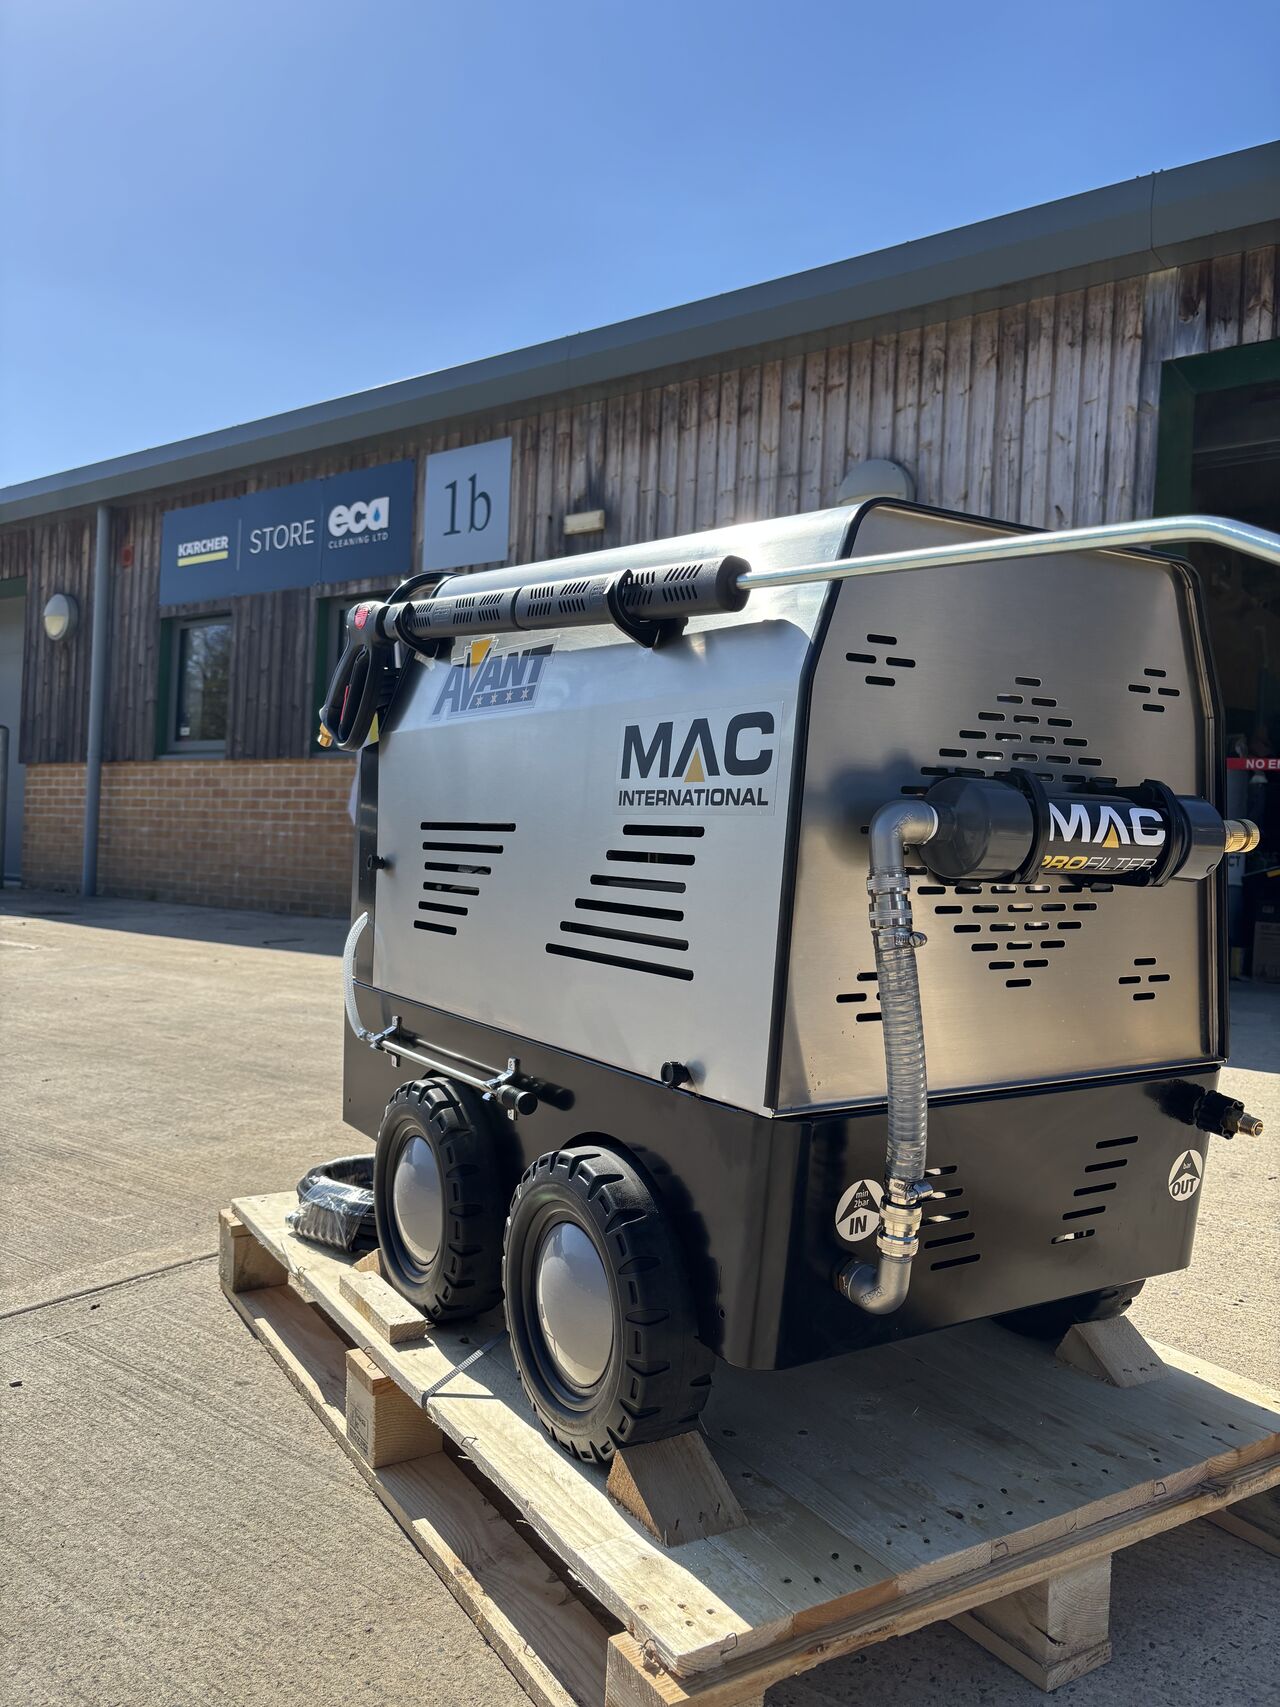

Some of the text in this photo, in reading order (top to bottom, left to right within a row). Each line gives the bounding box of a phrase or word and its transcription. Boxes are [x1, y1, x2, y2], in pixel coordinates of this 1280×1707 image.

[443, 473, 492, 536] 1b
[250, 519, 315, 554] STORE
[328, 532, 388, 549] CLEANING LTD
[432, 640, 554, 715] AVANT
[620, 711, 775, 783] MAC
[1246, 759, 1265, 769] NO
[618, 788, 768, 807] INTERNATIONAL
[1048, 802, 1166, 849] MAC
[856, 1190, 869, 1199] min
[1172, 1178, 1196, 1196] OUT
[854, 1199, 870, 1208] 2bar
[849, 1215, 868, 1235] IN
